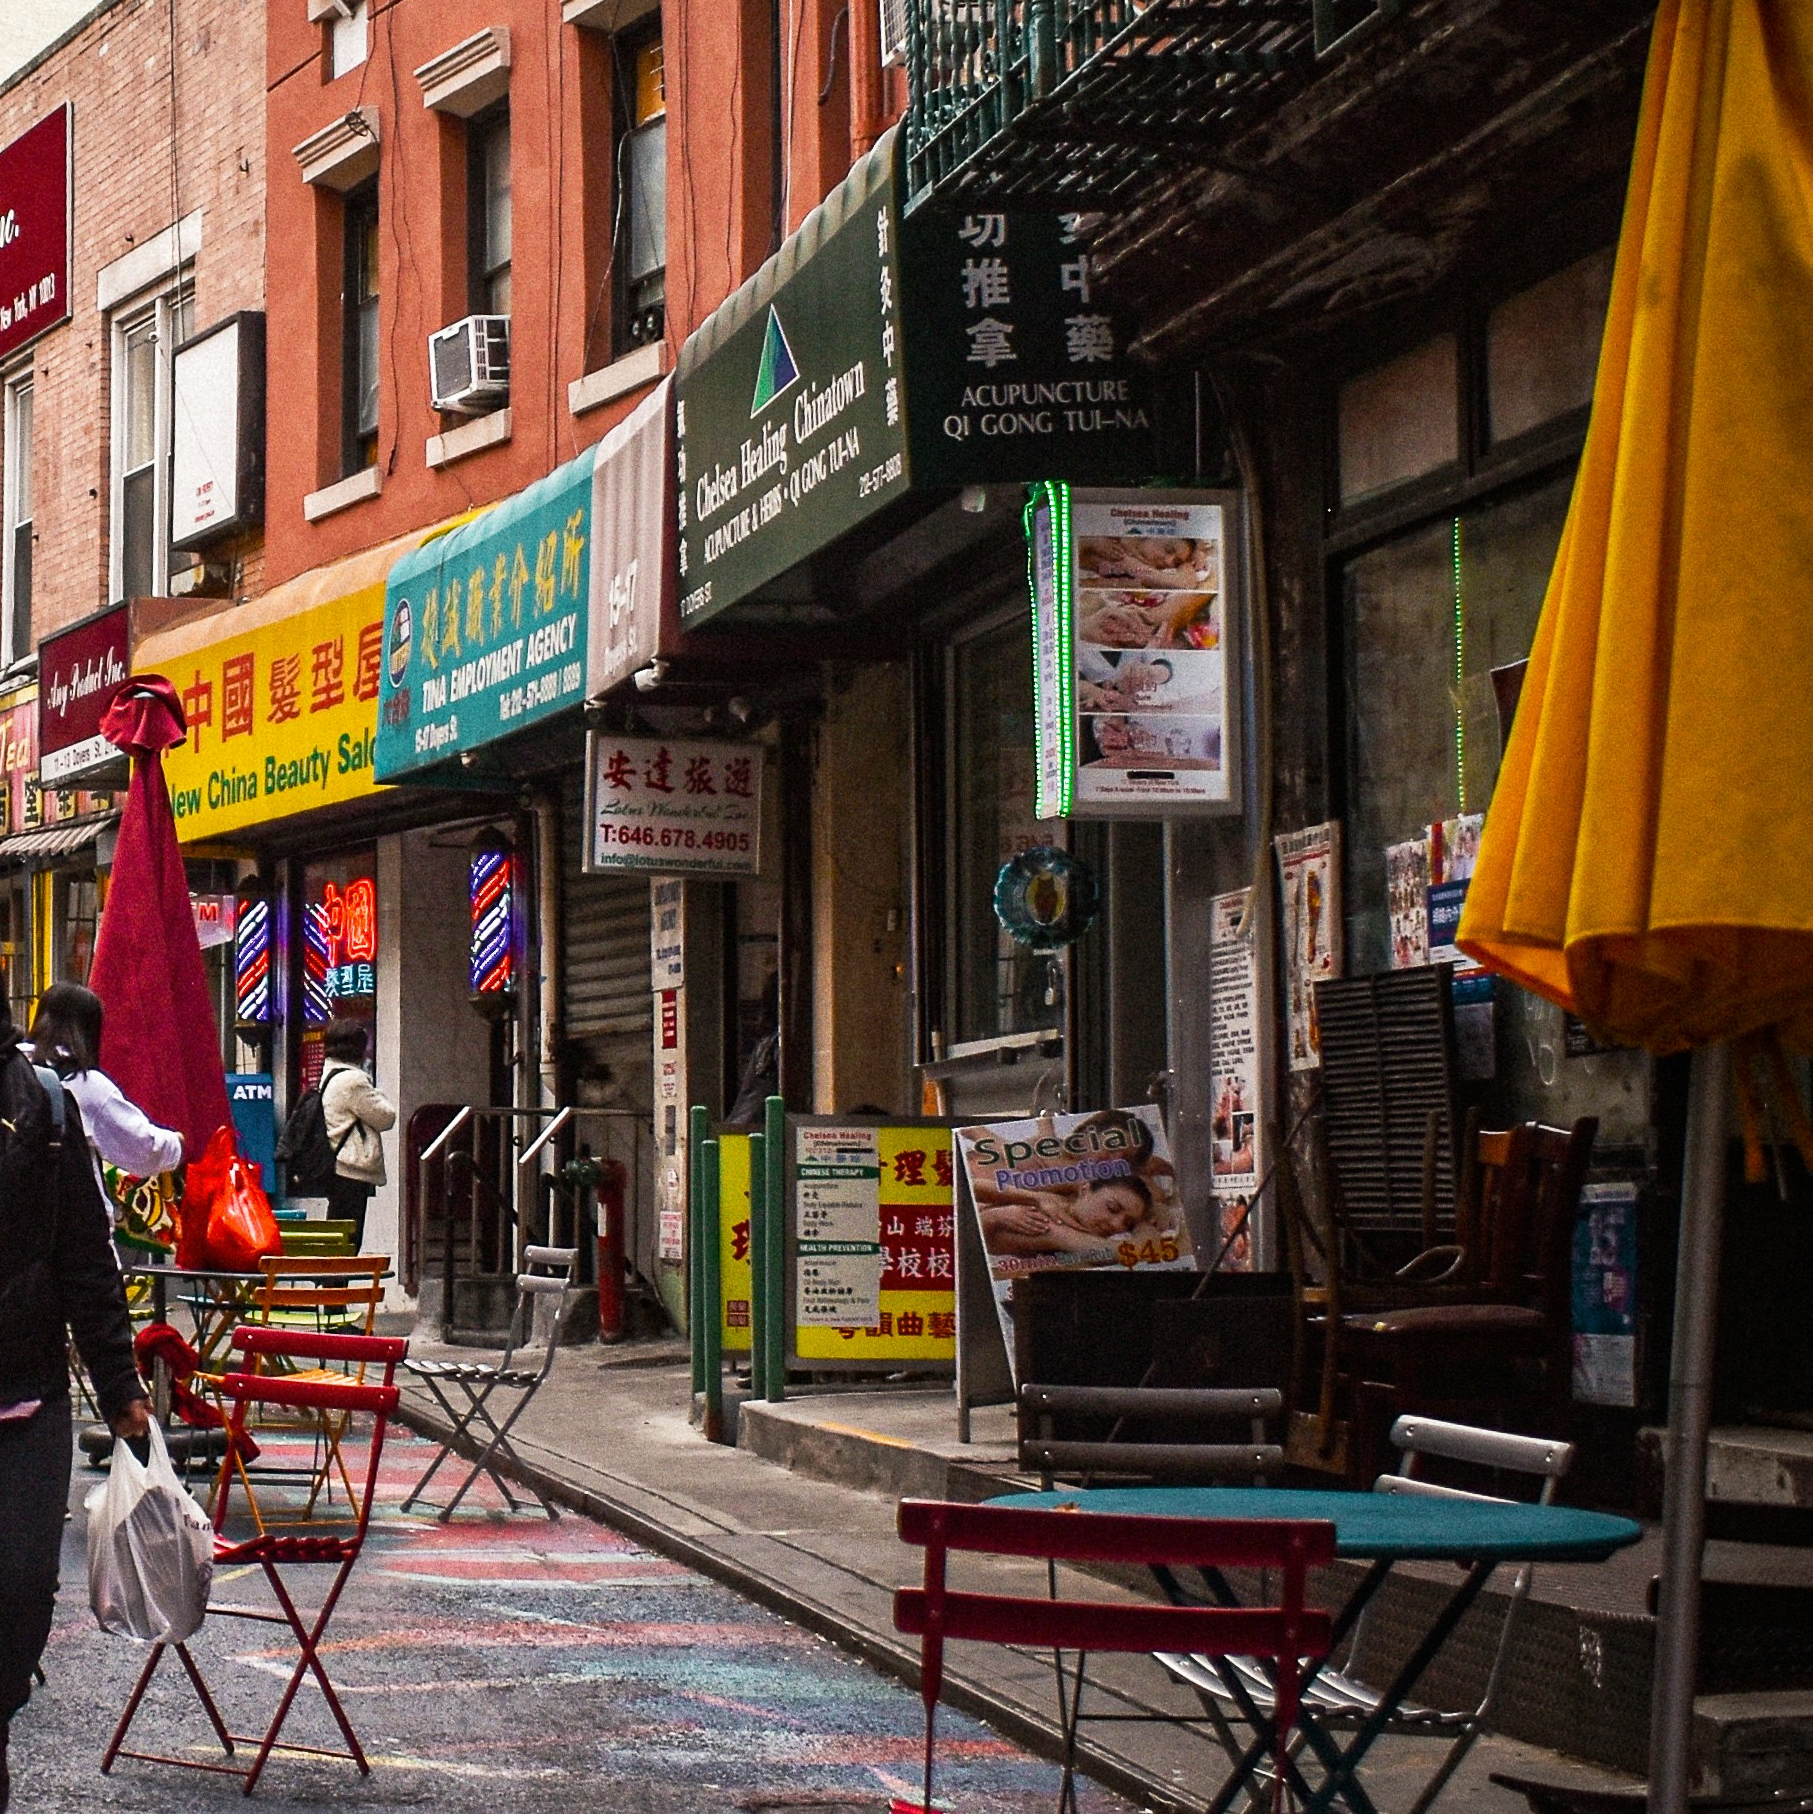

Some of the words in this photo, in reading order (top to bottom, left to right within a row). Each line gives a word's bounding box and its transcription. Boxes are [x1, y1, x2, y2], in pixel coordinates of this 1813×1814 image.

[961, 380, 1128, 407] ACUPUNCTURE
[696, 463, 737, 522] Chelsea
[740, 420, 787, 475] Healing
[794, 361, 865, 444] Chinatown
[943, 415, 969, 441] QI
[981, 411, 1053, 435] GONG
[704, 504, 750, 564] ACUPUNCTURE
[789, 470, 800, 507] QI
[801, 449, 827, 493] GONG
[1110, 508, 1148, 520] Chelsea
[1152, 508, 1190, 523] Healing
[422, 675, 446, 714] TINA
[450, 638, 524, 703] EMPLOYMENT
[526, 613, 577, 669] AGENCY
[47, 671, 68, 717] Any
[69, 656, 103, 701] Product
[104, 646, 126, 687] Inc.
[164, 621, 383, 758] 中國髮型屋
[208, 767, 258, 810] China
[265, 745, 331, 790] Beauty
[601, 798, 642, 816] Lotus
[650, 801, 722, 818] Wonderful
[600, 824, 749, 851] T:646.678.4905
[601, 853, 751, 870] info@lotuswonderful.com
[324, 879, 376, 966] 中國
[234, 1085, 272, 1101] ATM
[803, 1131, 836, 1141] Chelsea
[838, 1131, 872, 1142] Healing
[974, 1118, 1143, 1168] Special
[801, 1168, 829, 1177] CHINESE
[832, 1167, 864, 1177] THERAPY
[995, 1158, 1131, 1192] Promotion
[799, 1242, 827, 1253] HEALTH
[828, 1243, 873, 1253] PREVENTION
[1117, 1237, 1180, 1271] $45
